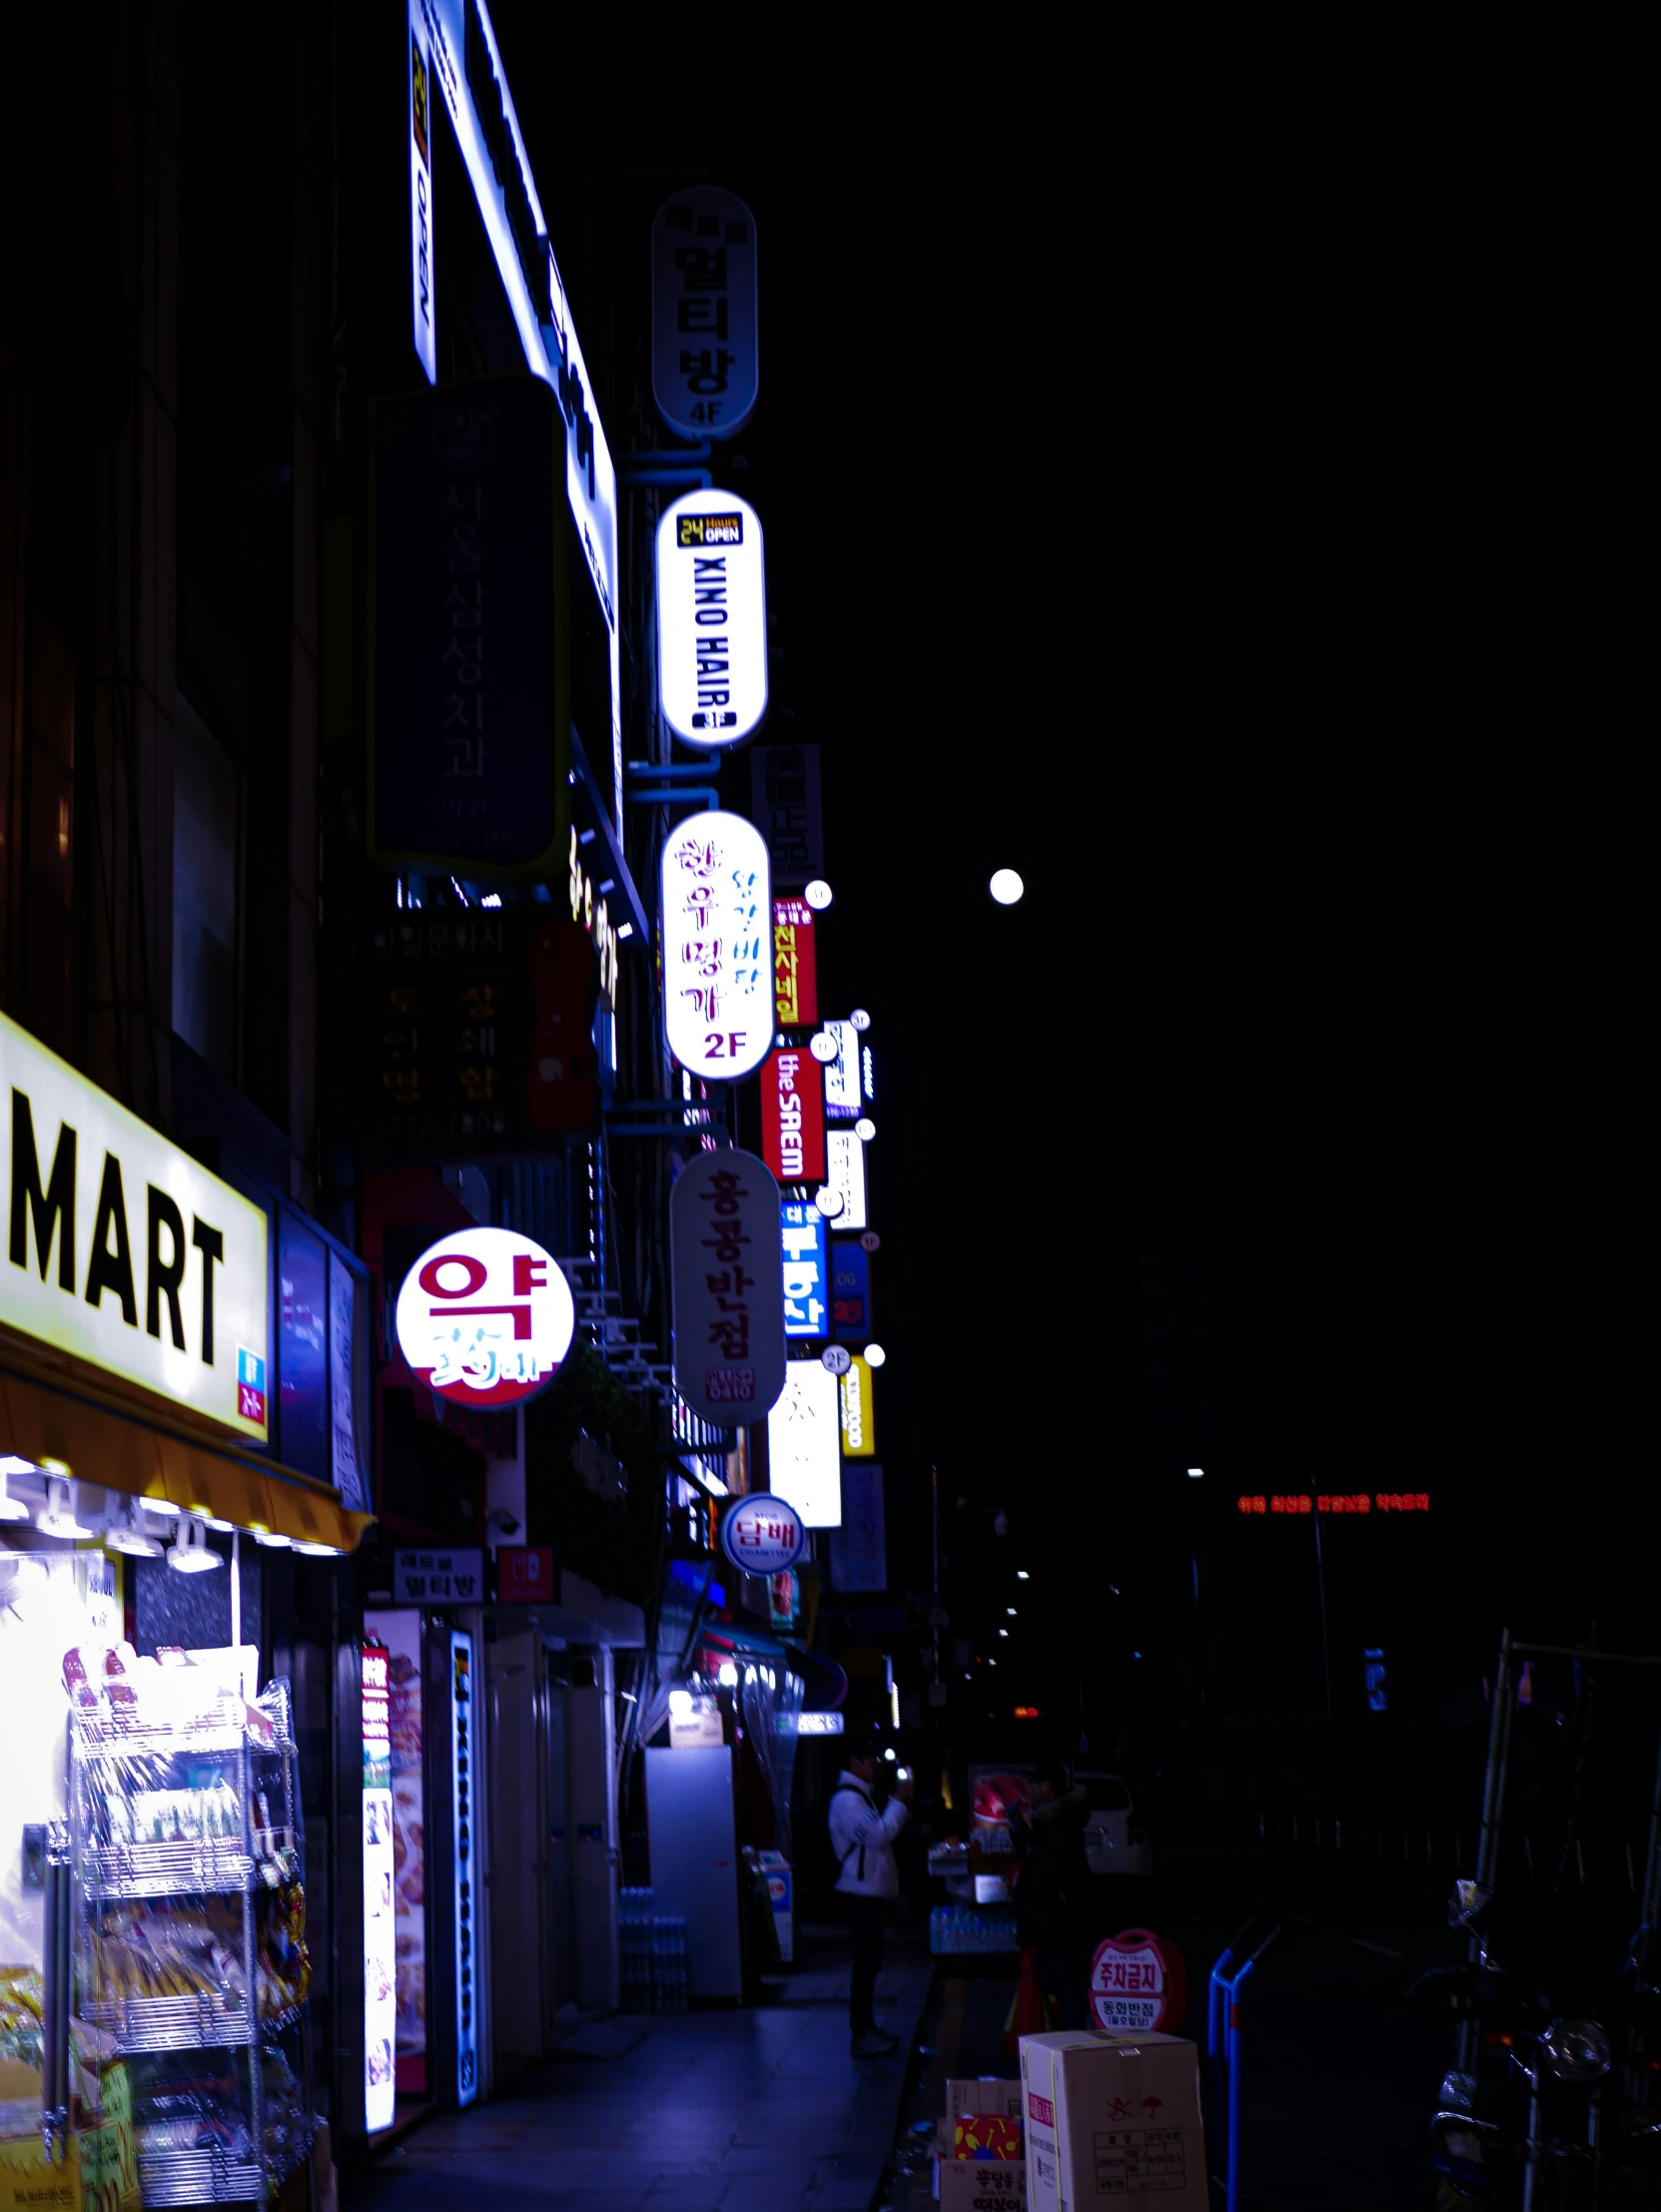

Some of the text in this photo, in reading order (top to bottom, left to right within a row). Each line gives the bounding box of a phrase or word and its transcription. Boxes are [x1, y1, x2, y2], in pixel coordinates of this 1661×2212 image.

[417, 169, 430, 329] OPEN
[676, 248, 736, 395] 멀티방
[690, 401, 723, 424] 4F
[681, 517, 704, 545] 24
[705, 526, 739, 542] OPEN
[439, 479, 489, 780] 서울삼성치과
[693, 556, 730, 708] XINO HAIR
[704, 1032, 747, 1059] 2F
[778, 1093, 804, 1176] SAEM
[10, 1086, 224, 1367] MART
[699, 1168, 755, 1361] 홍콩반점
[418, 1248, 547, 1341] 약
[736, 1520, 795, 1550] 담배
[1101, 1963, 1156, 1990] 주차금지
[1104, 2001, 1154, 2017] 동화반점
